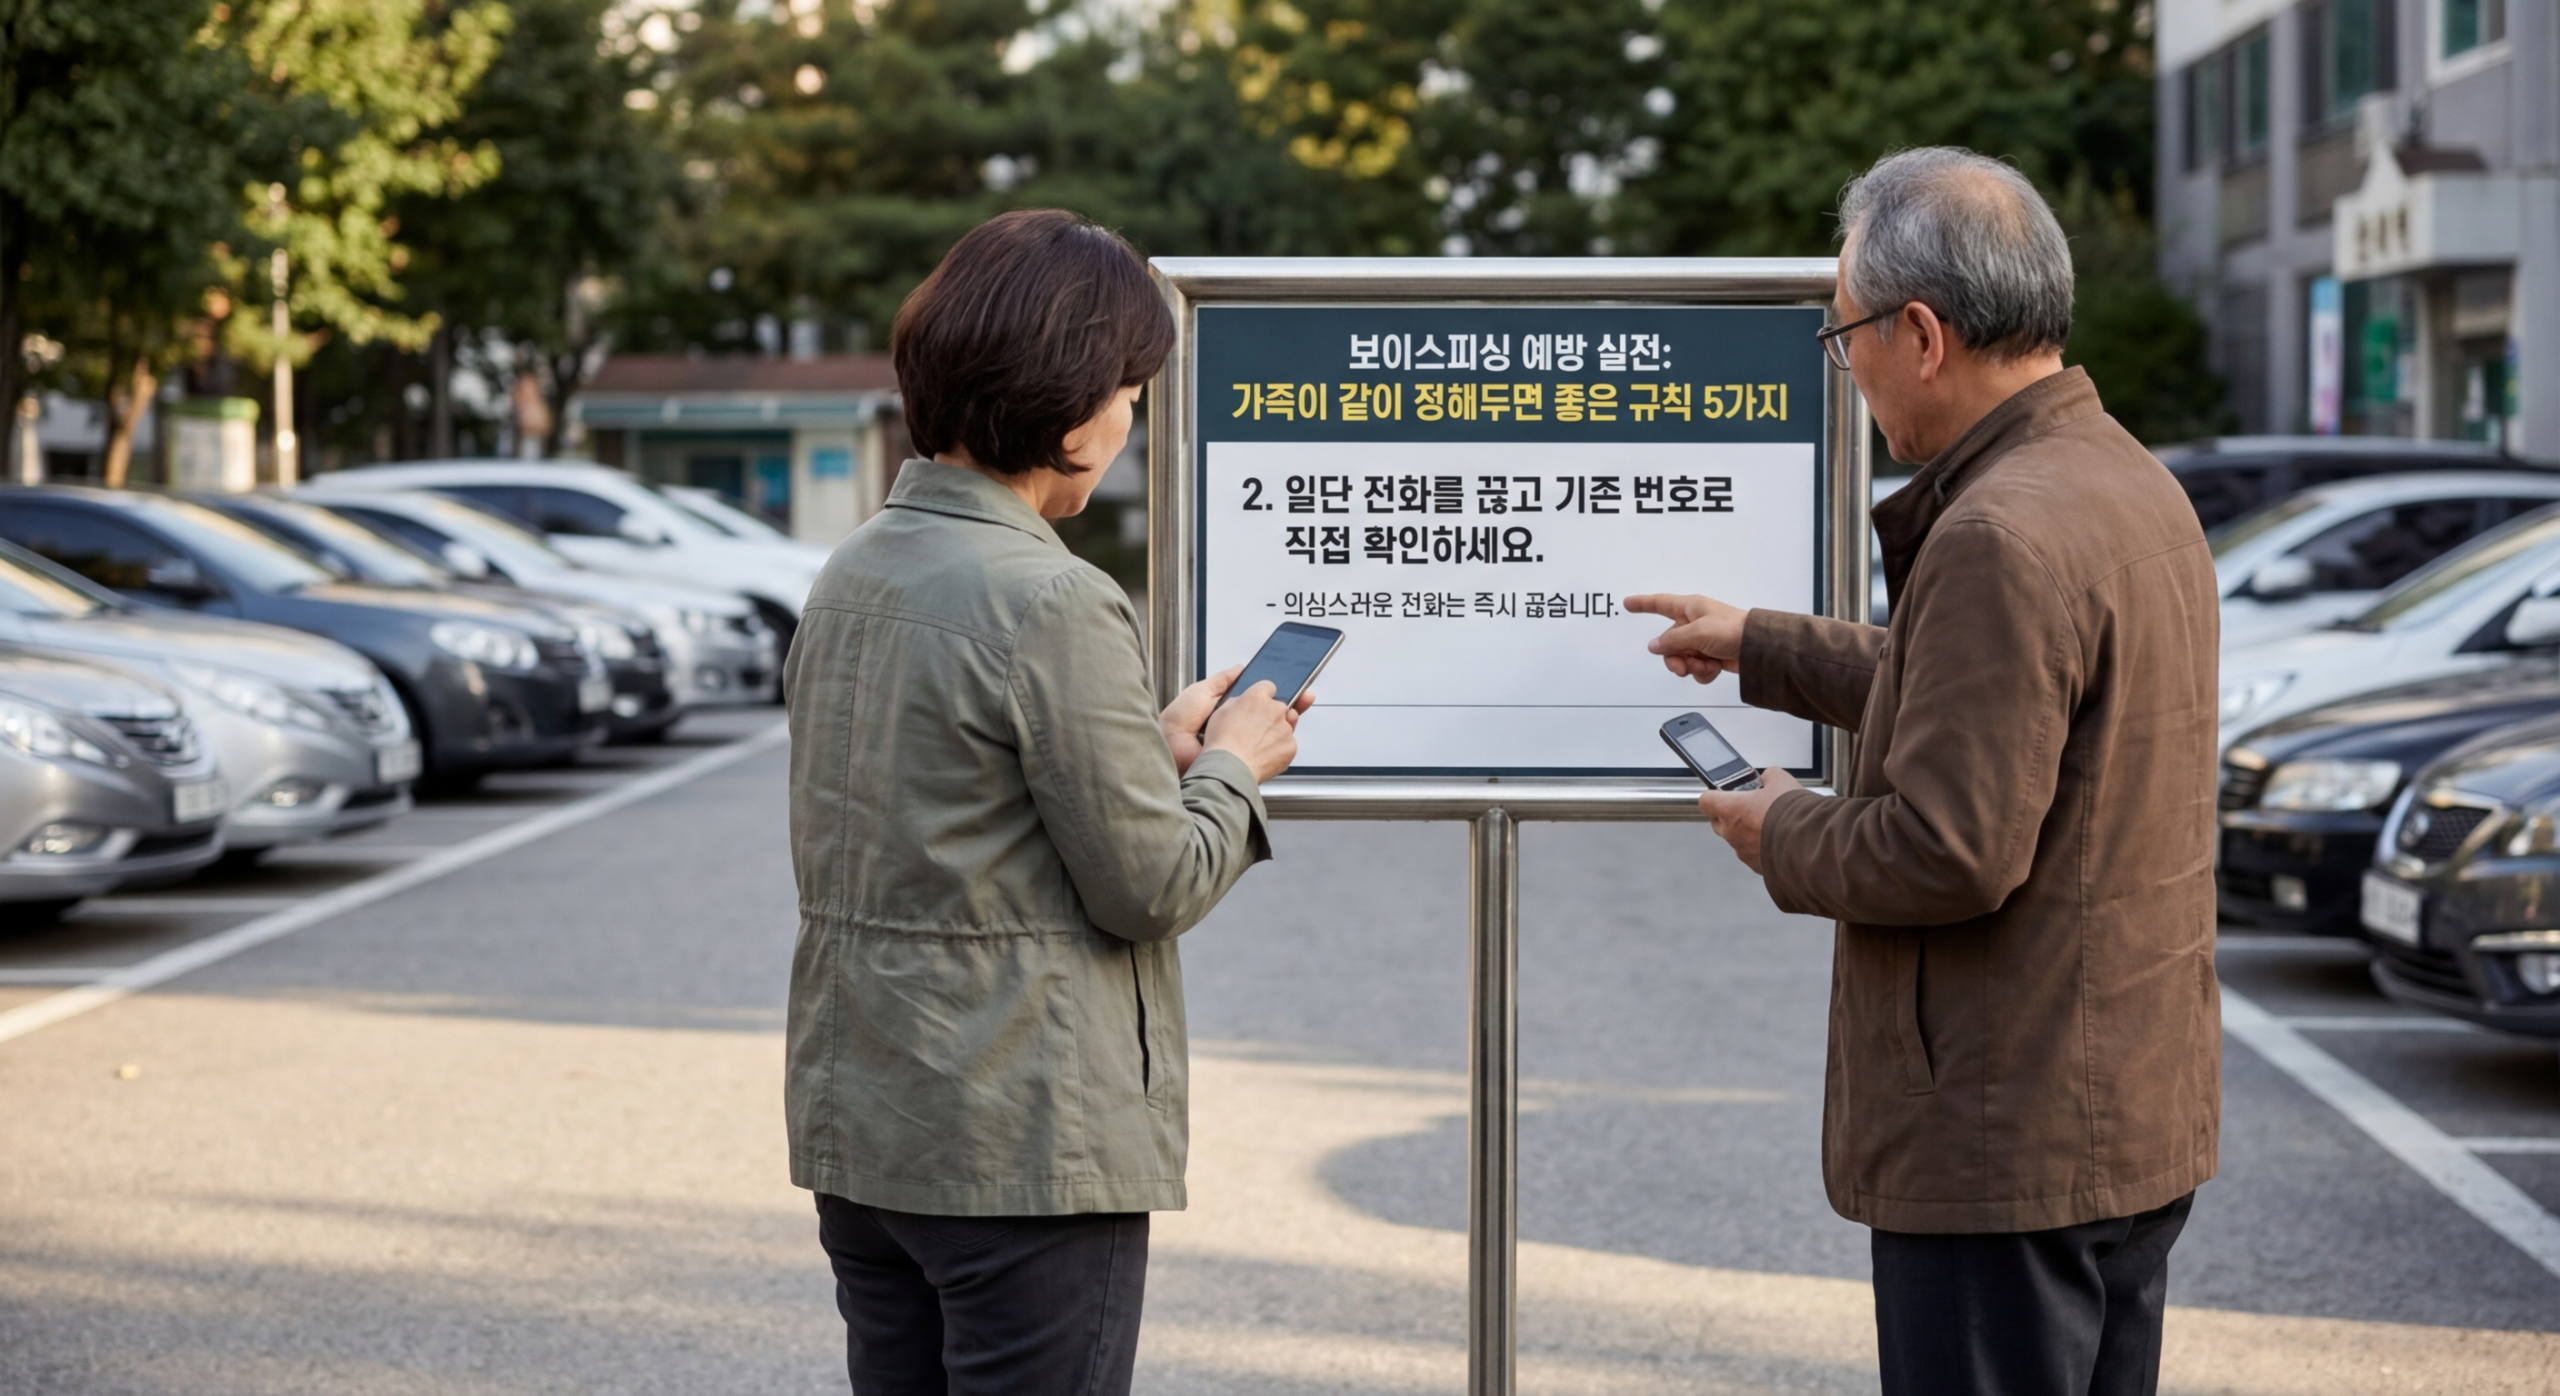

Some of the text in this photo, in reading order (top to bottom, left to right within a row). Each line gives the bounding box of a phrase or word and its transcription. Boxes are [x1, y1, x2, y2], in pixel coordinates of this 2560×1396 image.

[1349, 333, 1672, 372] 보이스피싱 예방 실전:
[1231, 382, 1788, 422] 가족이 같이 정해두면 좋은 규칙 5가지
[1242, 475, 1735, 515] 2. 일단 전화를 끊고 기존 번호로
[1284, 525, 1544, 565] 직접 확인하세요.
[1284, 591, 1393, 618] 의심스러운
[1401, 591, 1466, 618] 전화는
[1473, 592, 1516, 618] 즉시
